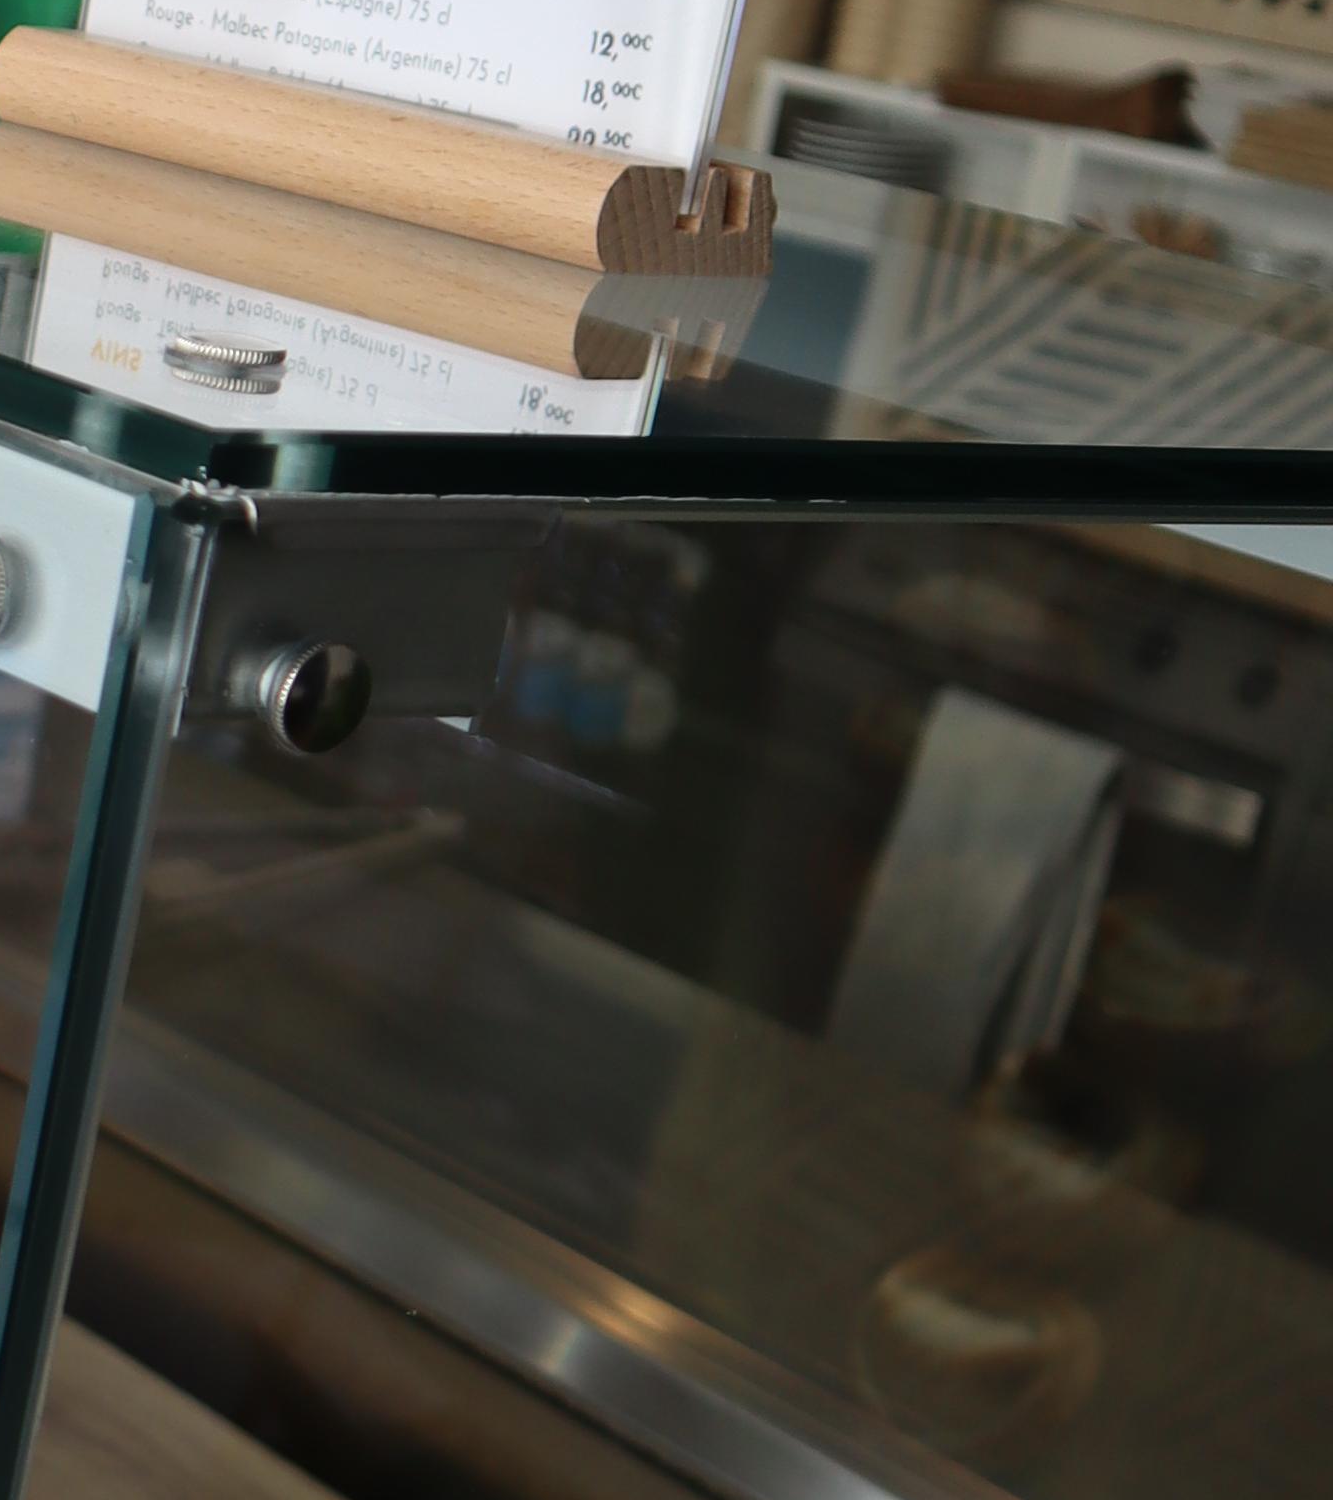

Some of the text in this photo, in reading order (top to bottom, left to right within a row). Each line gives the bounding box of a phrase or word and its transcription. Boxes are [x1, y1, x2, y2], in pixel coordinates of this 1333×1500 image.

[212, 8, 268, 41] Malbec
[275, 21, 357, 57] Patagonie
[364, 37, 462, 80] (Argentine)
[467, 56, 488, 82] 75
